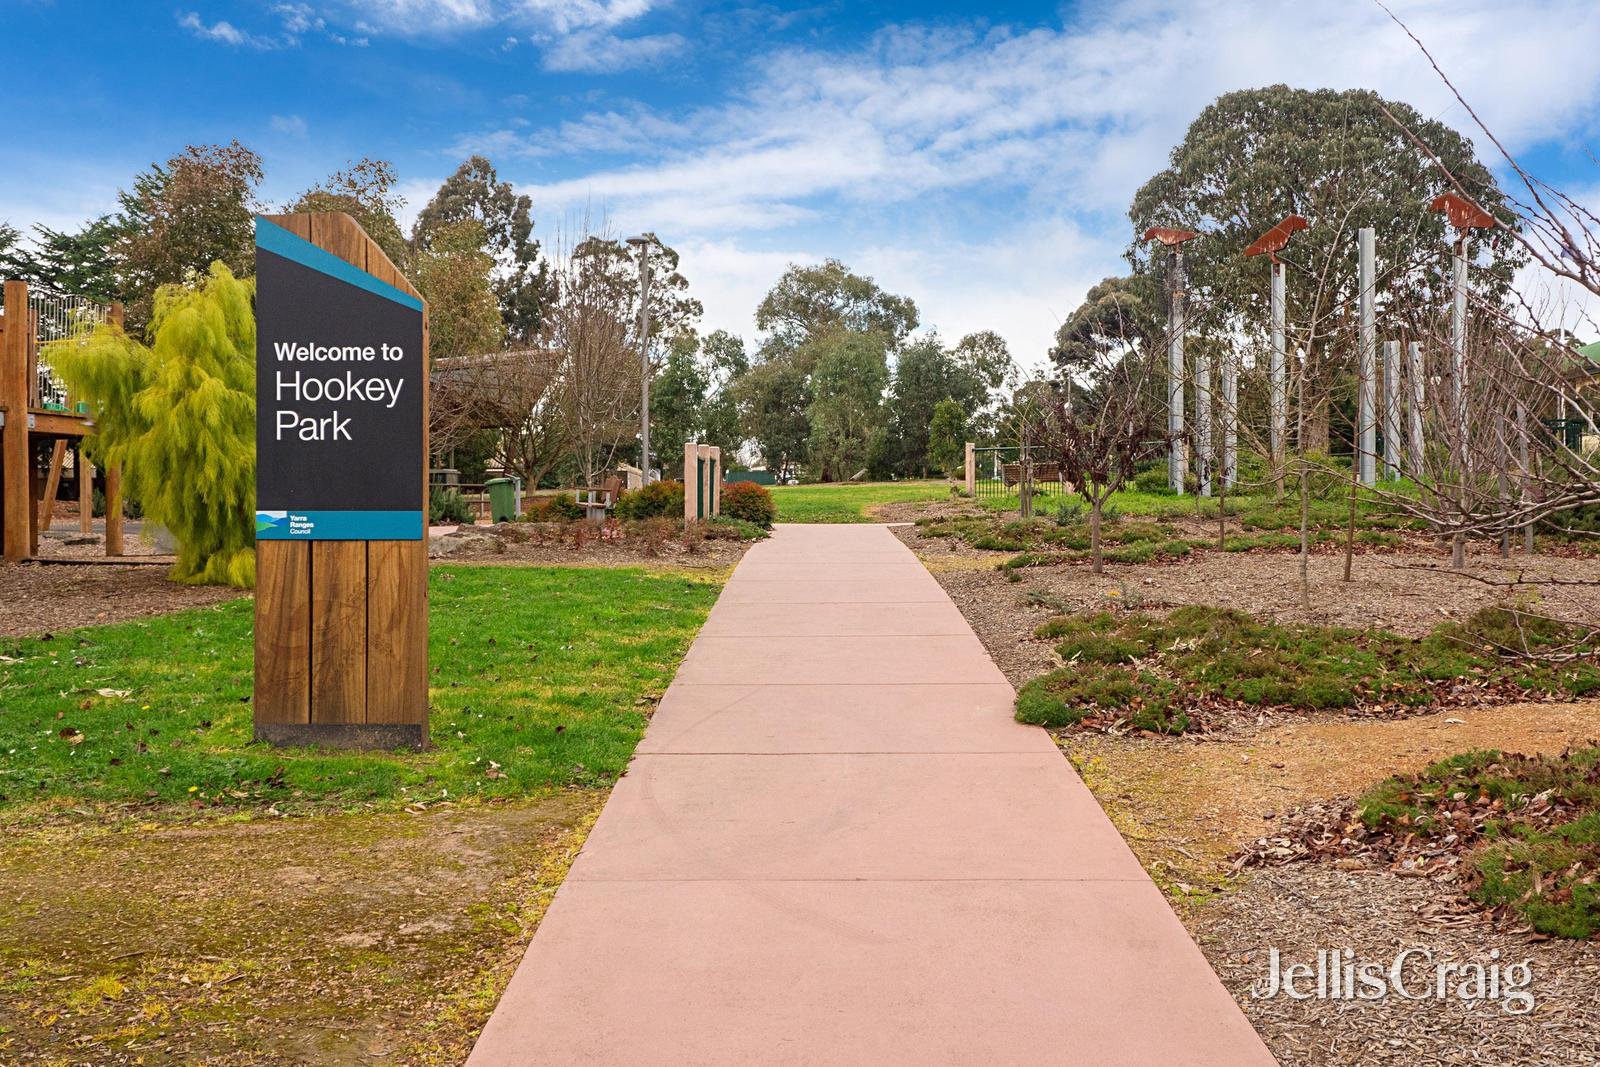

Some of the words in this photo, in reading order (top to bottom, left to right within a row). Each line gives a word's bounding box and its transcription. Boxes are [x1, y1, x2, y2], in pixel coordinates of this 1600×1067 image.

[274, 342, 375, 361] Welcome
[381, 343, 403, 361] to
[276, 371, 404, 408] Hookey
[276, 411, 352, 441] Park
